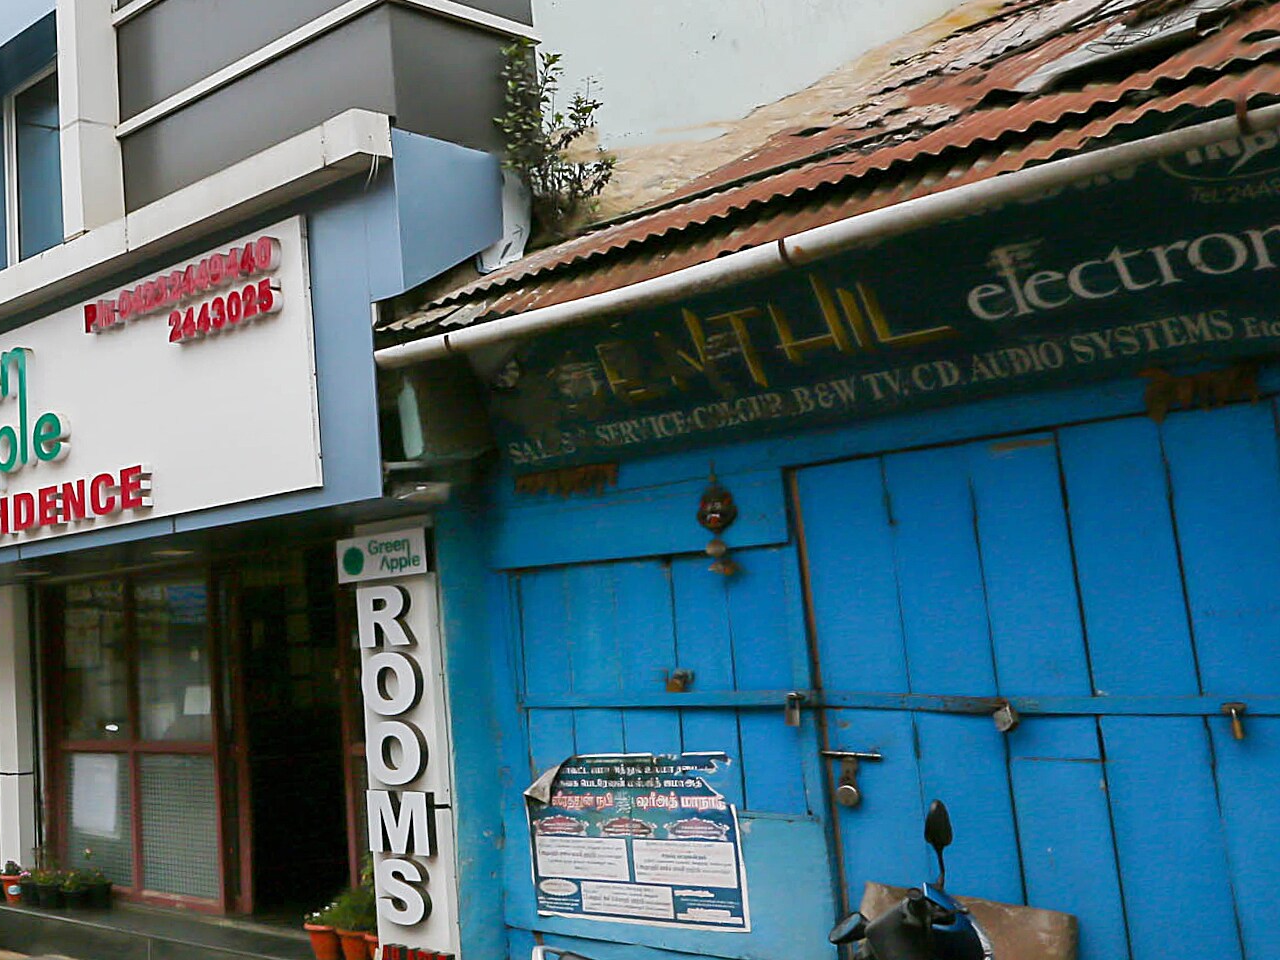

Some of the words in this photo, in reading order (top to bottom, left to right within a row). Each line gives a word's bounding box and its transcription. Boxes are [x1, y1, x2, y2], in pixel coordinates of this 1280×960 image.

[169, 278, 274, 343] 2443025
[971, 340, 1065, 382] AUDIO
[1071, 309, 1234, 364] SYSTEMS
[368, 538, 410, 556] Green
[381, 554, 421, 573] Apple
[357, 584, 433, 927] ROOMS
